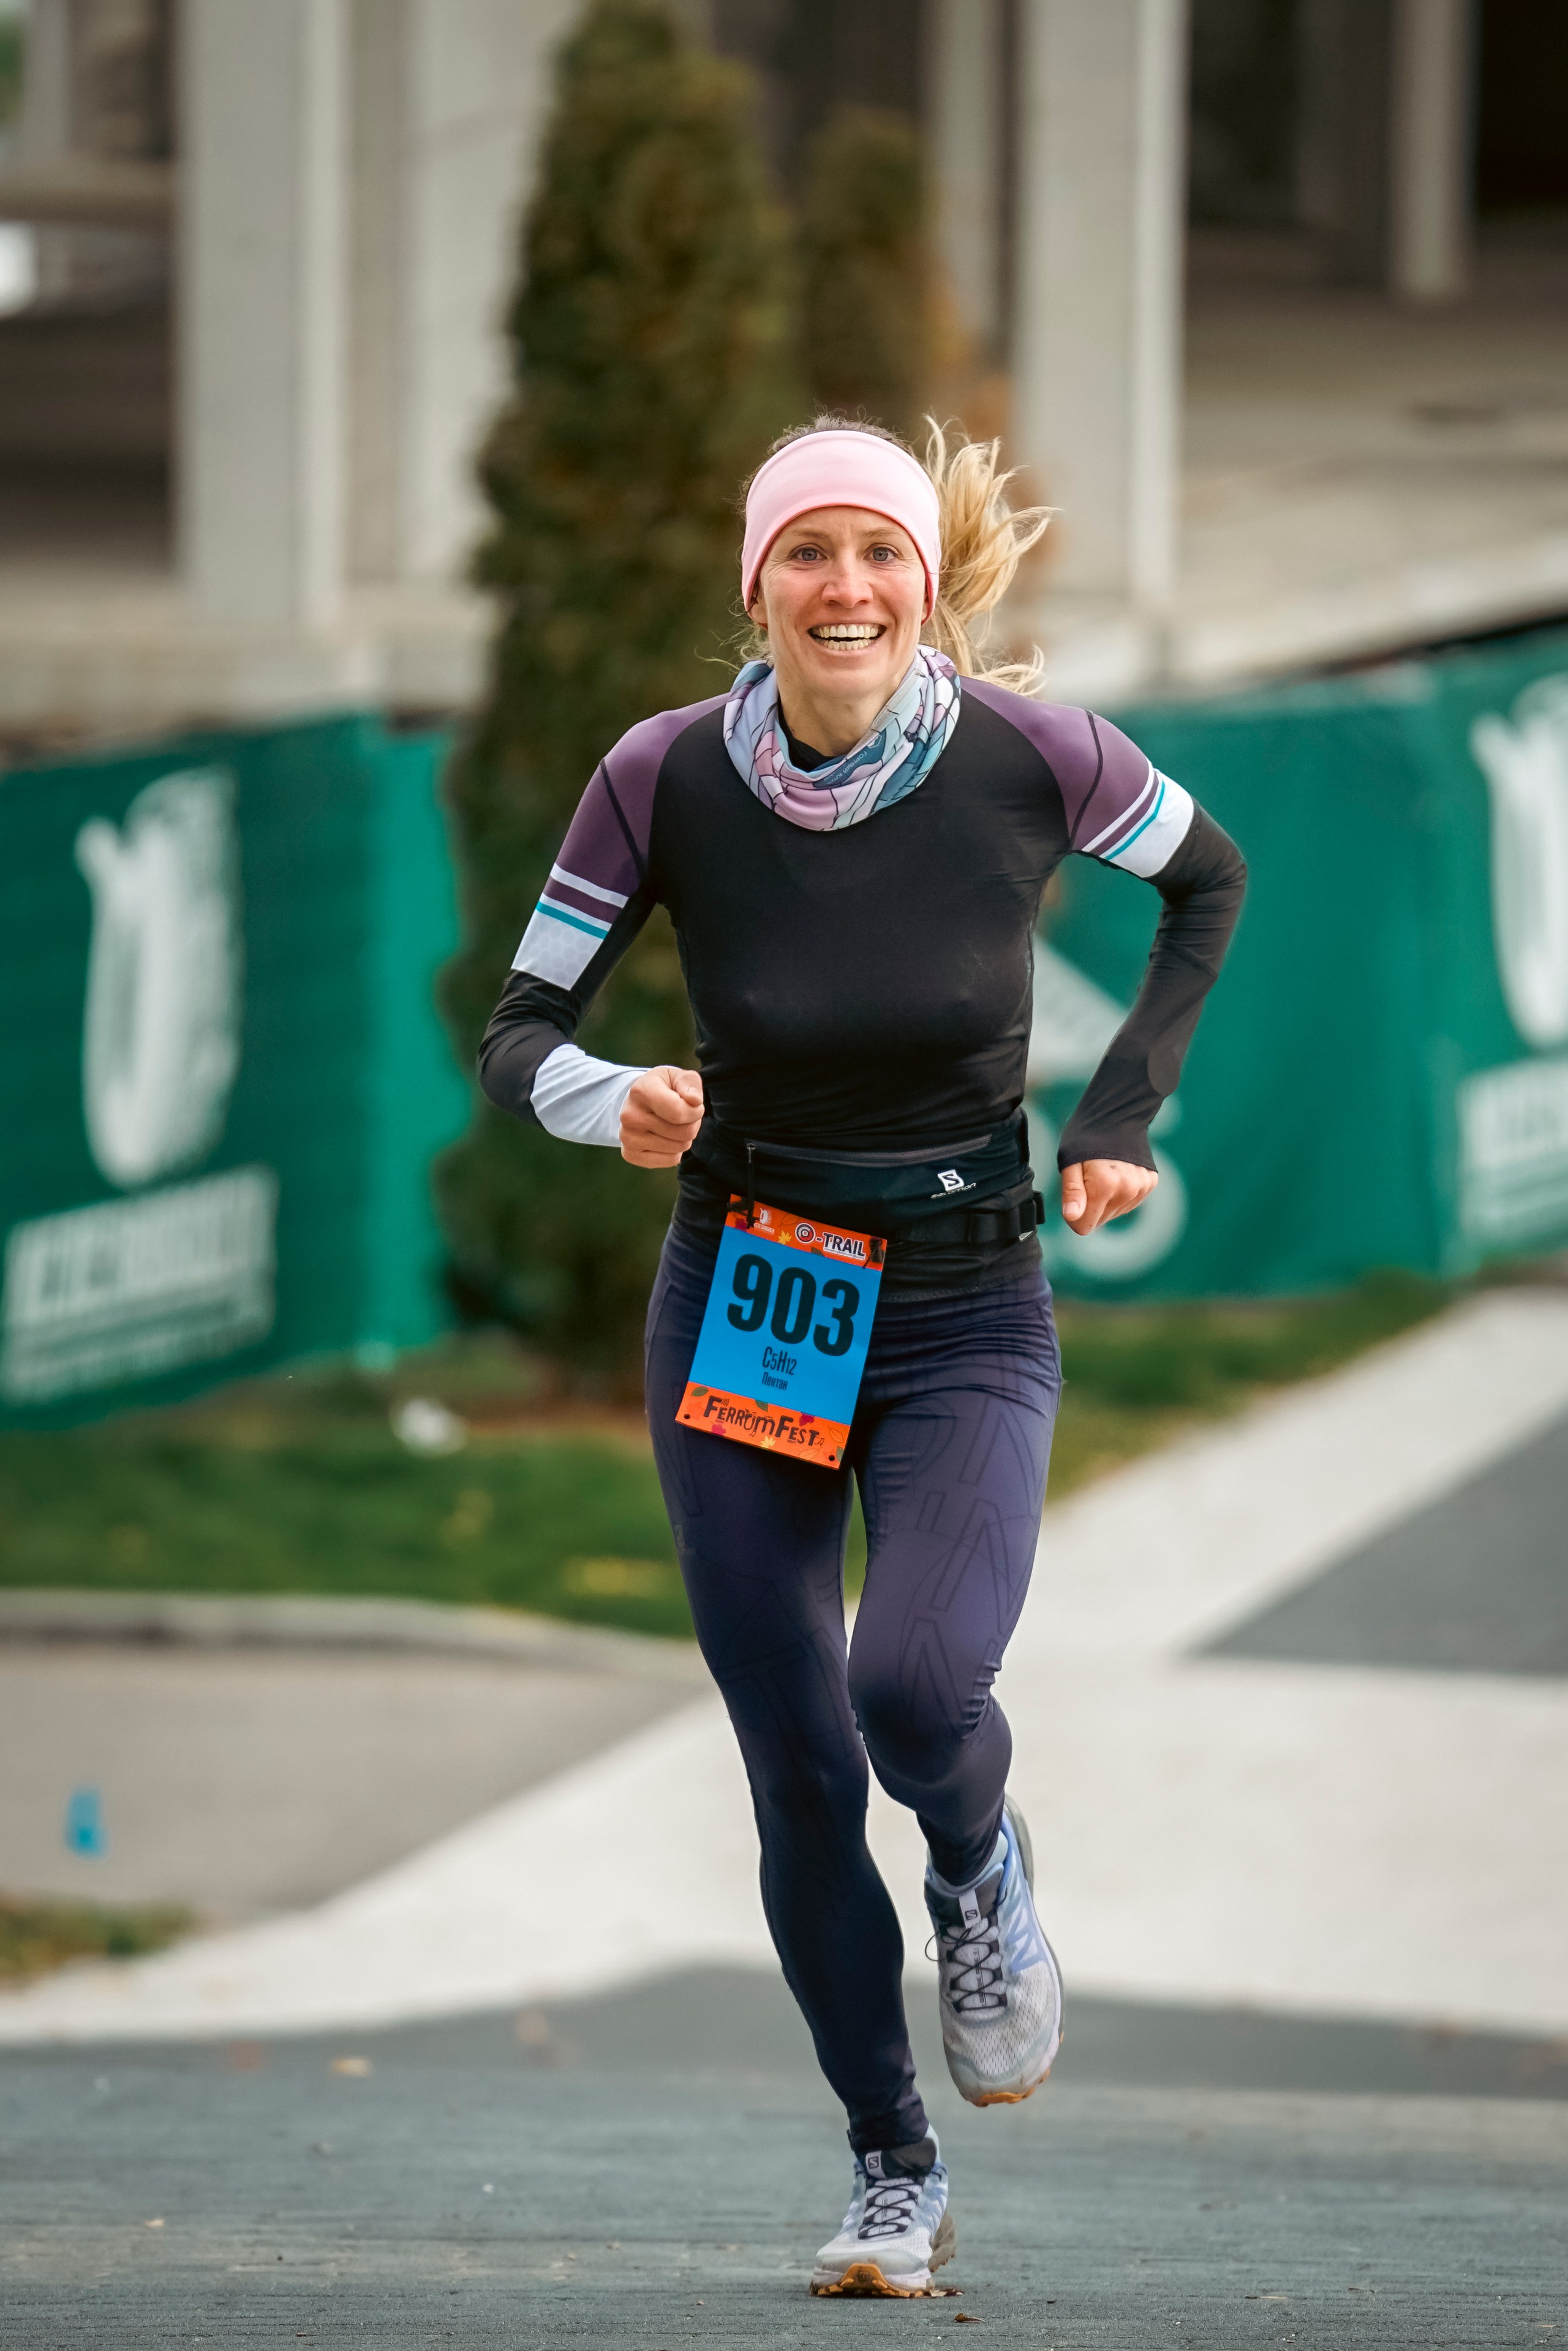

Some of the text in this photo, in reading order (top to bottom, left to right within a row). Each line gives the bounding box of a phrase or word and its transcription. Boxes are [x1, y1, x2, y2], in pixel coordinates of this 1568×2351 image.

[842, 750, 867, 774] ГОРНЫЙ
[727, 1253, 860, 1357] 903
[762, 1346, 797, 1376] C5H12
[761, 1371, 788, 1391] Пентан
